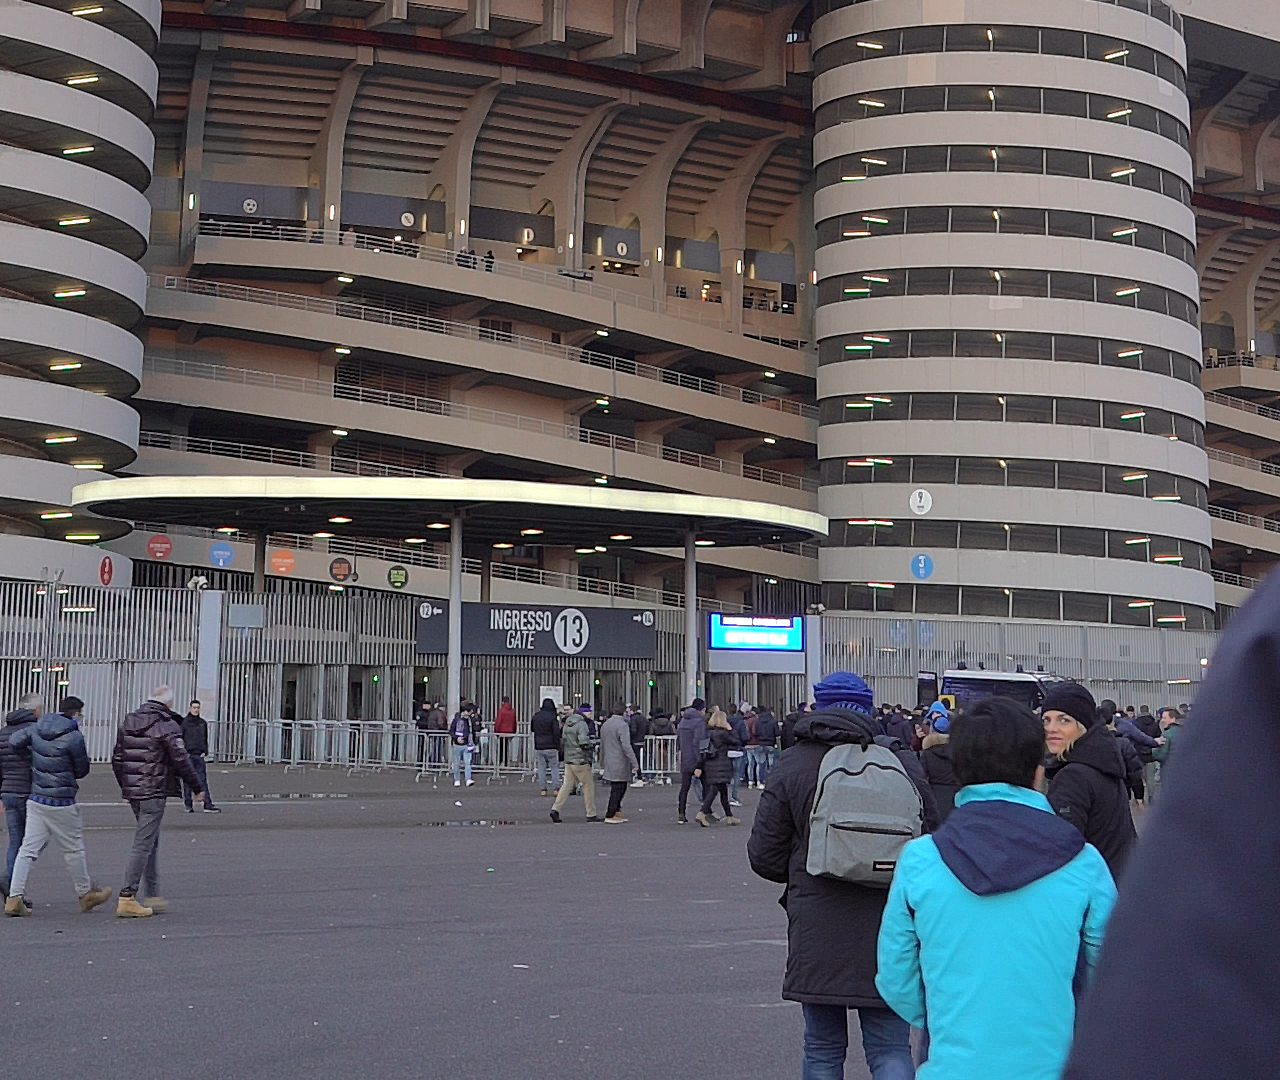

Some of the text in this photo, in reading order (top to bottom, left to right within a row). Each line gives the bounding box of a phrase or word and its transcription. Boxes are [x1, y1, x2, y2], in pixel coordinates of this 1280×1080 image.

[421, 604, 431, 617] 12
[490, 609, 583, 648] INGRESSO 13
[506, 630, 536, 649] GATE
